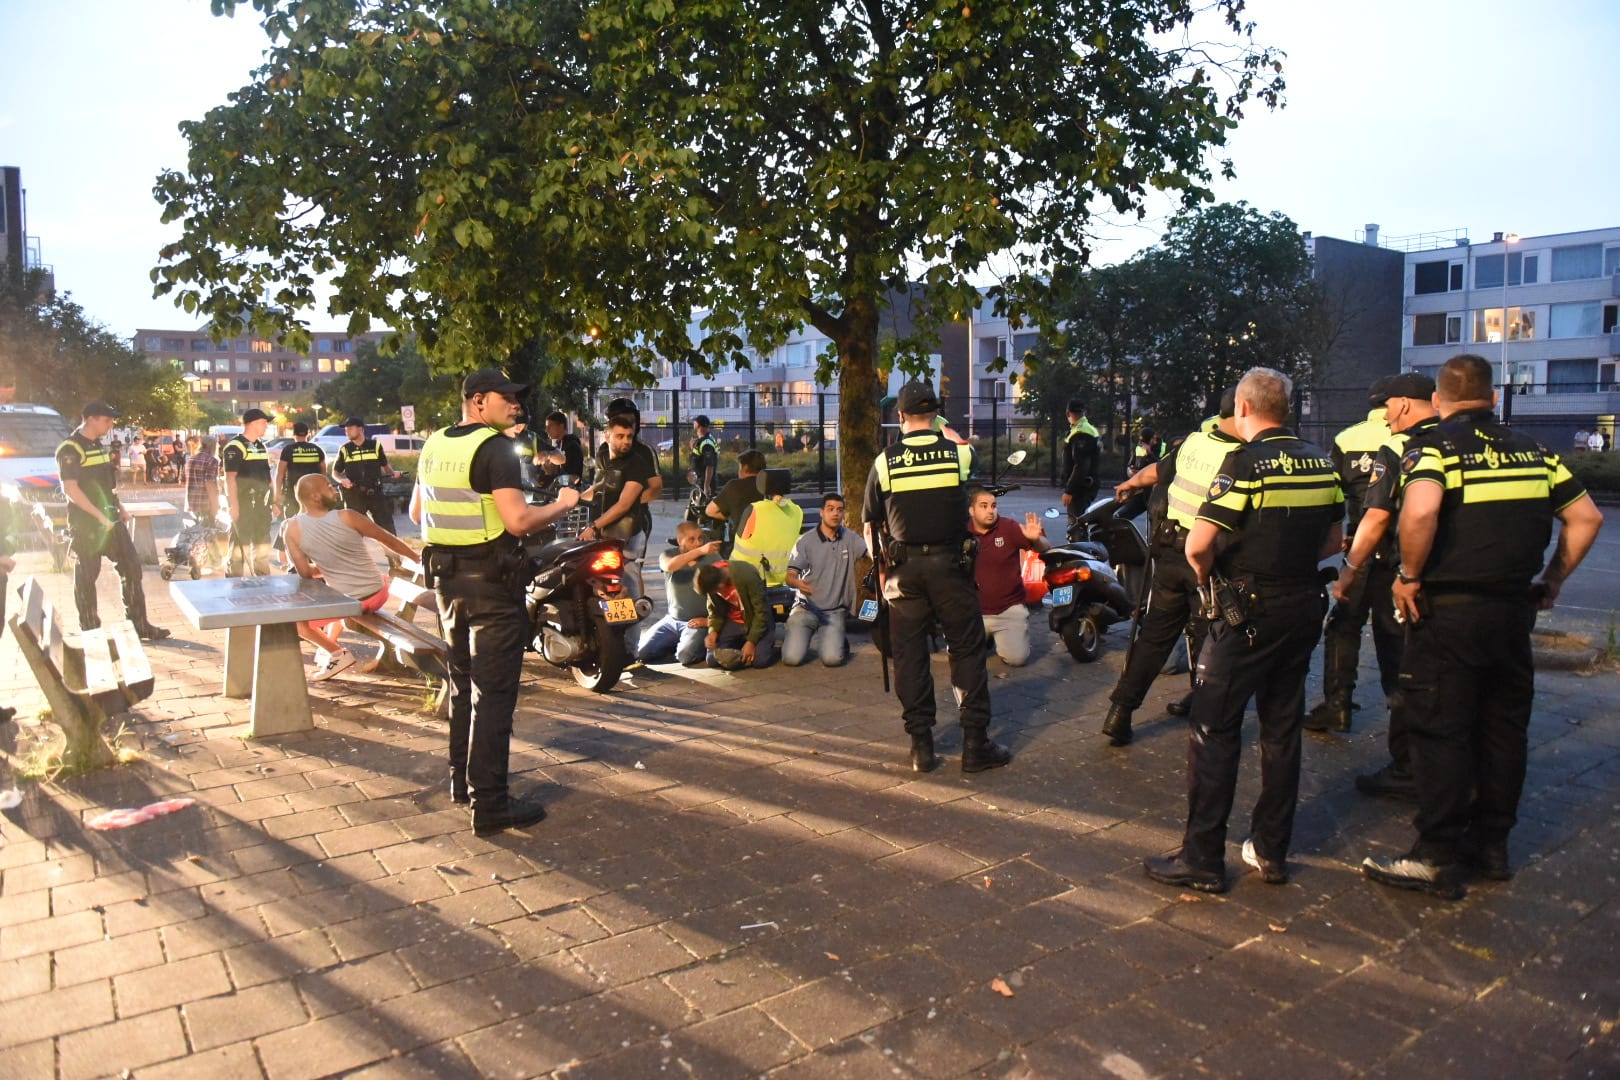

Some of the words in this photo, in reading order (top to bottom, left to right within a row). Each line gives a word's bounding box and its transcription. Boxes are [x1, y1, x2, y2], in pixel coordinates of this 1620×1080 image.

[896, 448, 950, 466] POLITIE
[1271, 451, 1327, 474] POLITIE
[1475, 444, 1536, 468] POLITIE
